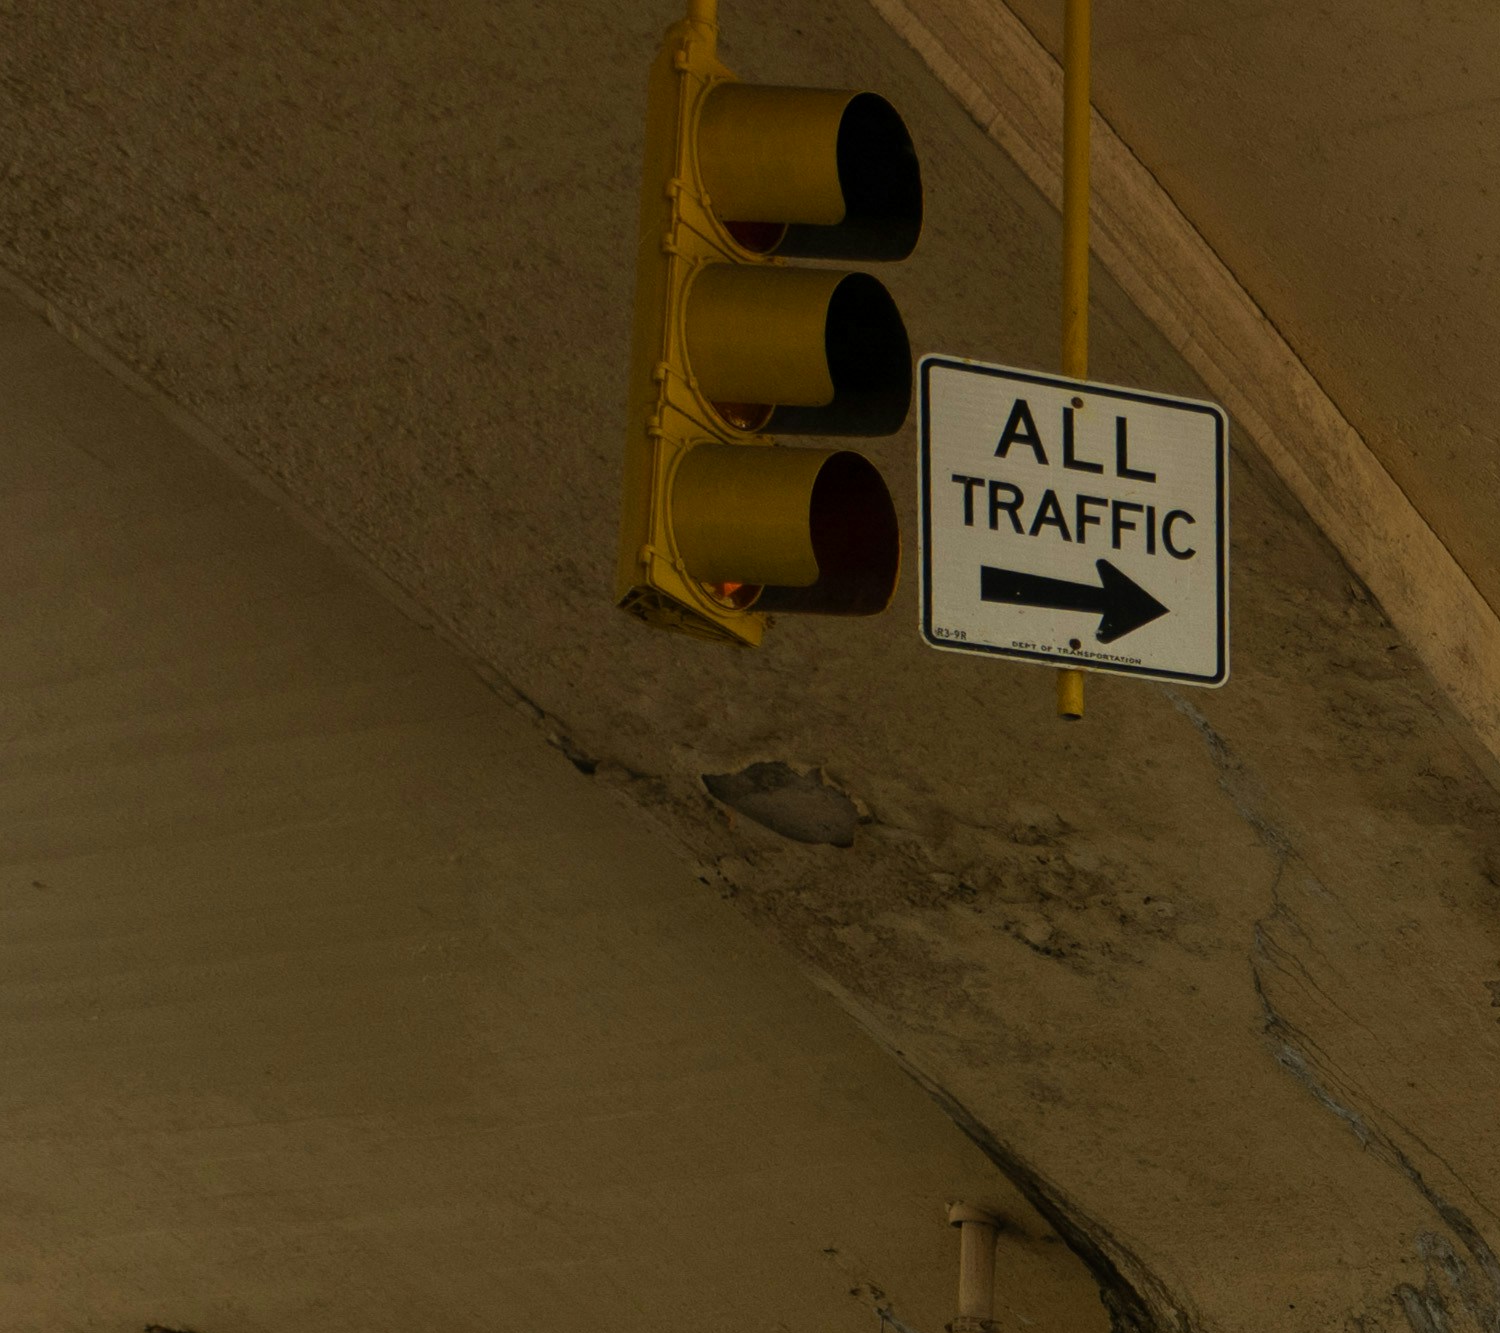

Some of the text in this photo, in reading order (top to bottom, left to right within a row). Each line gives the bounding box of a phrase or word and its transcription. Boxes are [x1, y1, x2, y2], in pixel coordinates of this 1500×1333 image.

[994, 399, 1156, 483] ALL
[951, 474, 1196, 560] TRAFFIC
[936, 627, 967, 640] R3-9R
[1012, 640, 1142, 665] DEPT OF TRANSPORTATION
